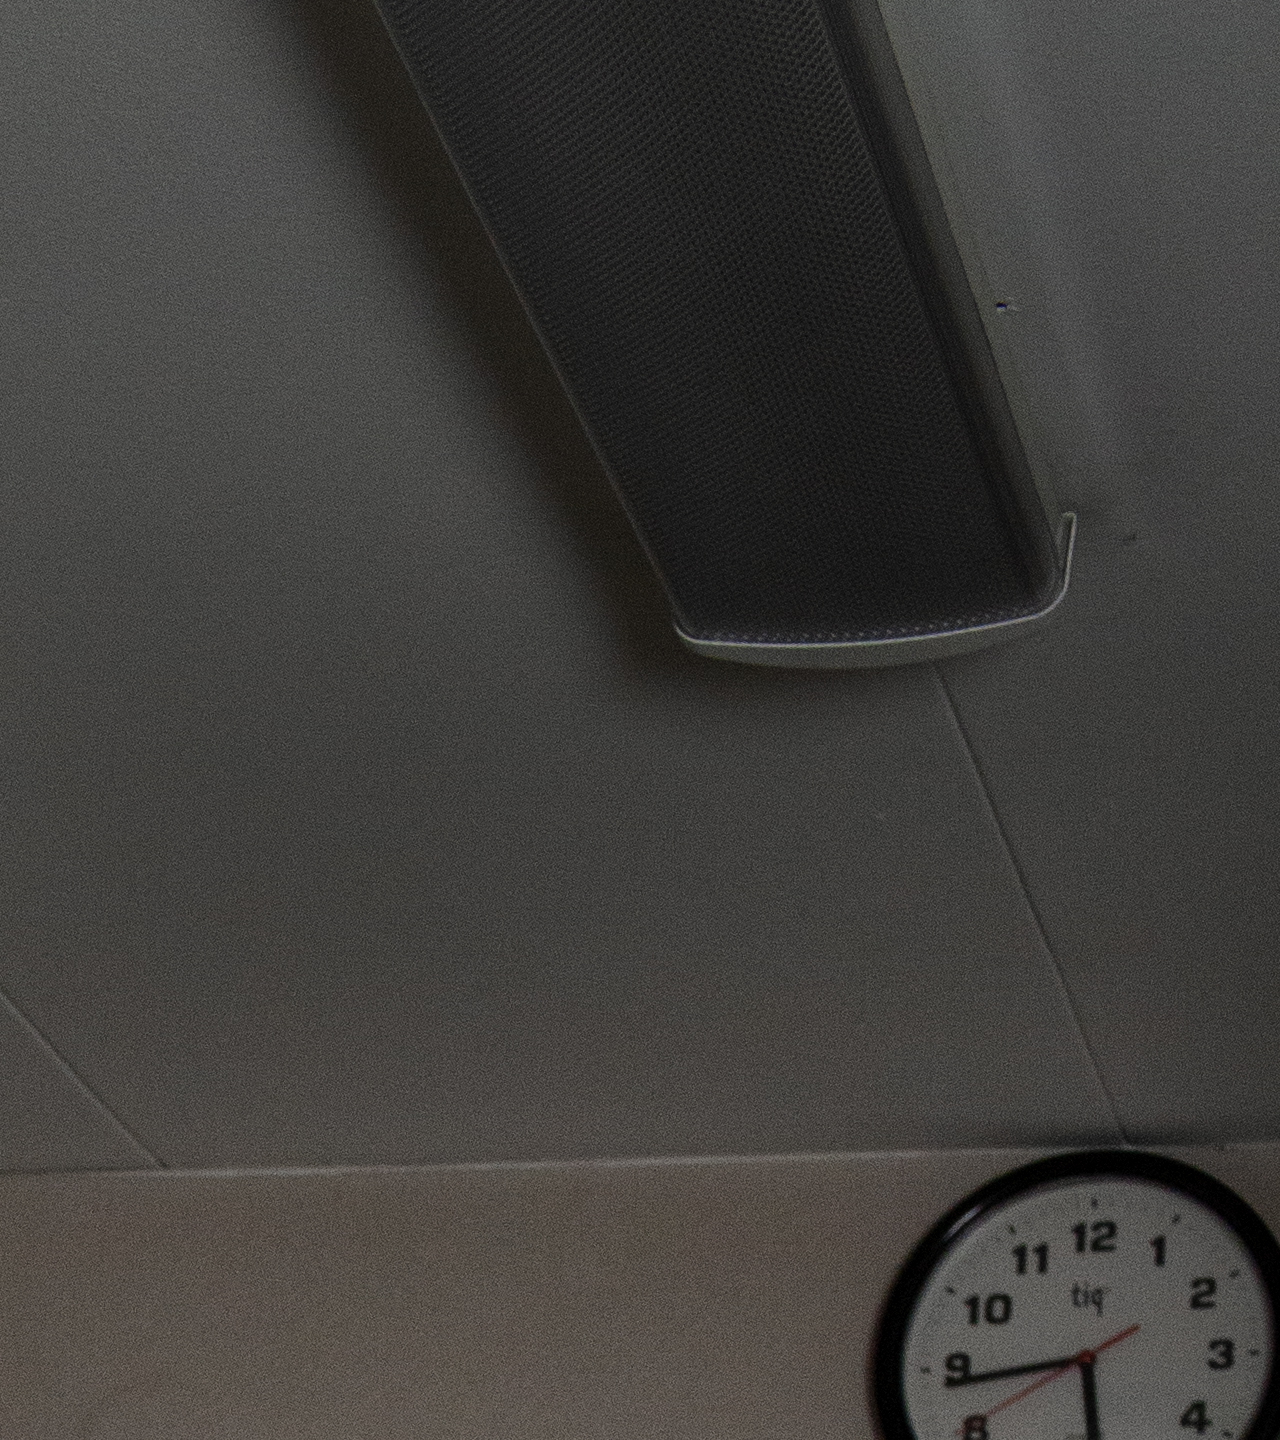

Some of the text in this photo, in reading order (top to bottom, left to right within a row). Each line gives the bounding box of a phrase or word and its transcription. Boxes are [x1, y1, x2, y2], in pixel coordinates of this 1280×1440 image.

[1071, 1220, 1118, 1254] 12
[1150, 1235, 1167, 1267] 1
[1012, 1242, 1050, 1275] 11
[1189, 1276, 1217, 1309] 2
[964, 1293, 1013, 1326] 10
[945, 1352, 972, 1386] 9
[1207, 1338, 1236, 1371] 3
[1178, 1401, 1211, 1435] 4
